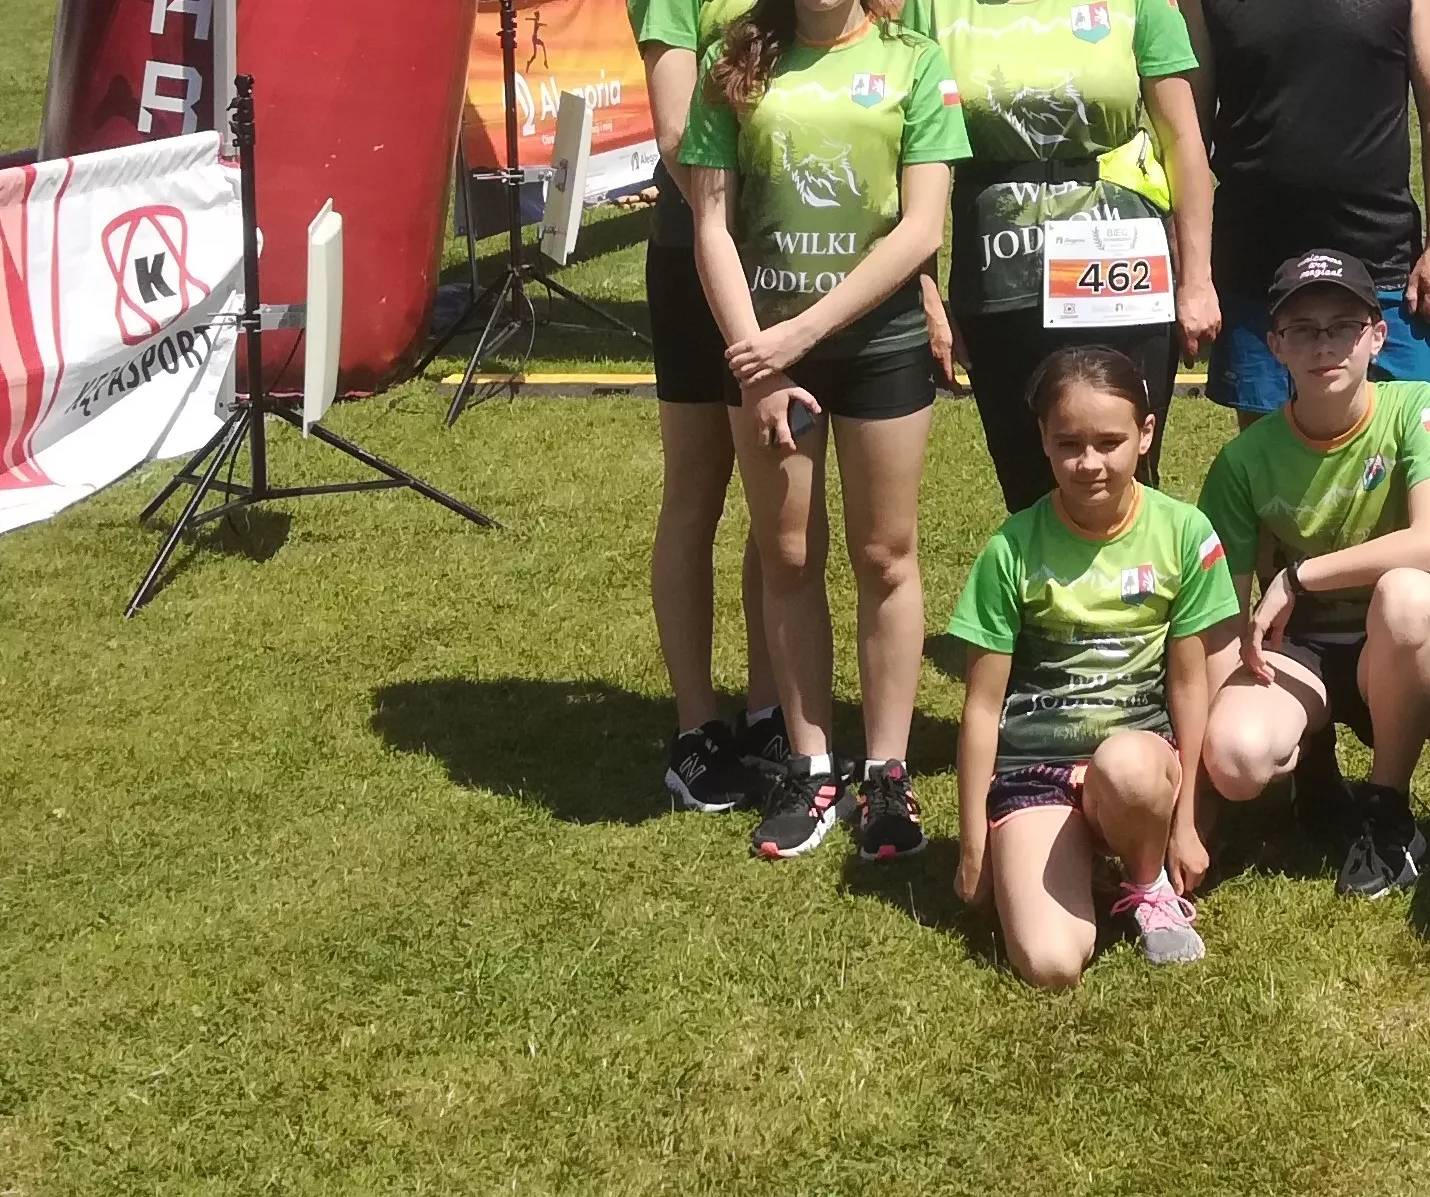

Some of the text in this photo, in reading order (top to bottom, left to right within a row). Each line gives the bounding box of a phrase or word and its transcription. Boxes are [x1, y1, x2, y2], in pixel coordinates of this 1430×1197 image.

[774, 231, 857, 255] WILKI
[133, 251, 178, 305] K
[1077, 259, 1151, 293] 462
